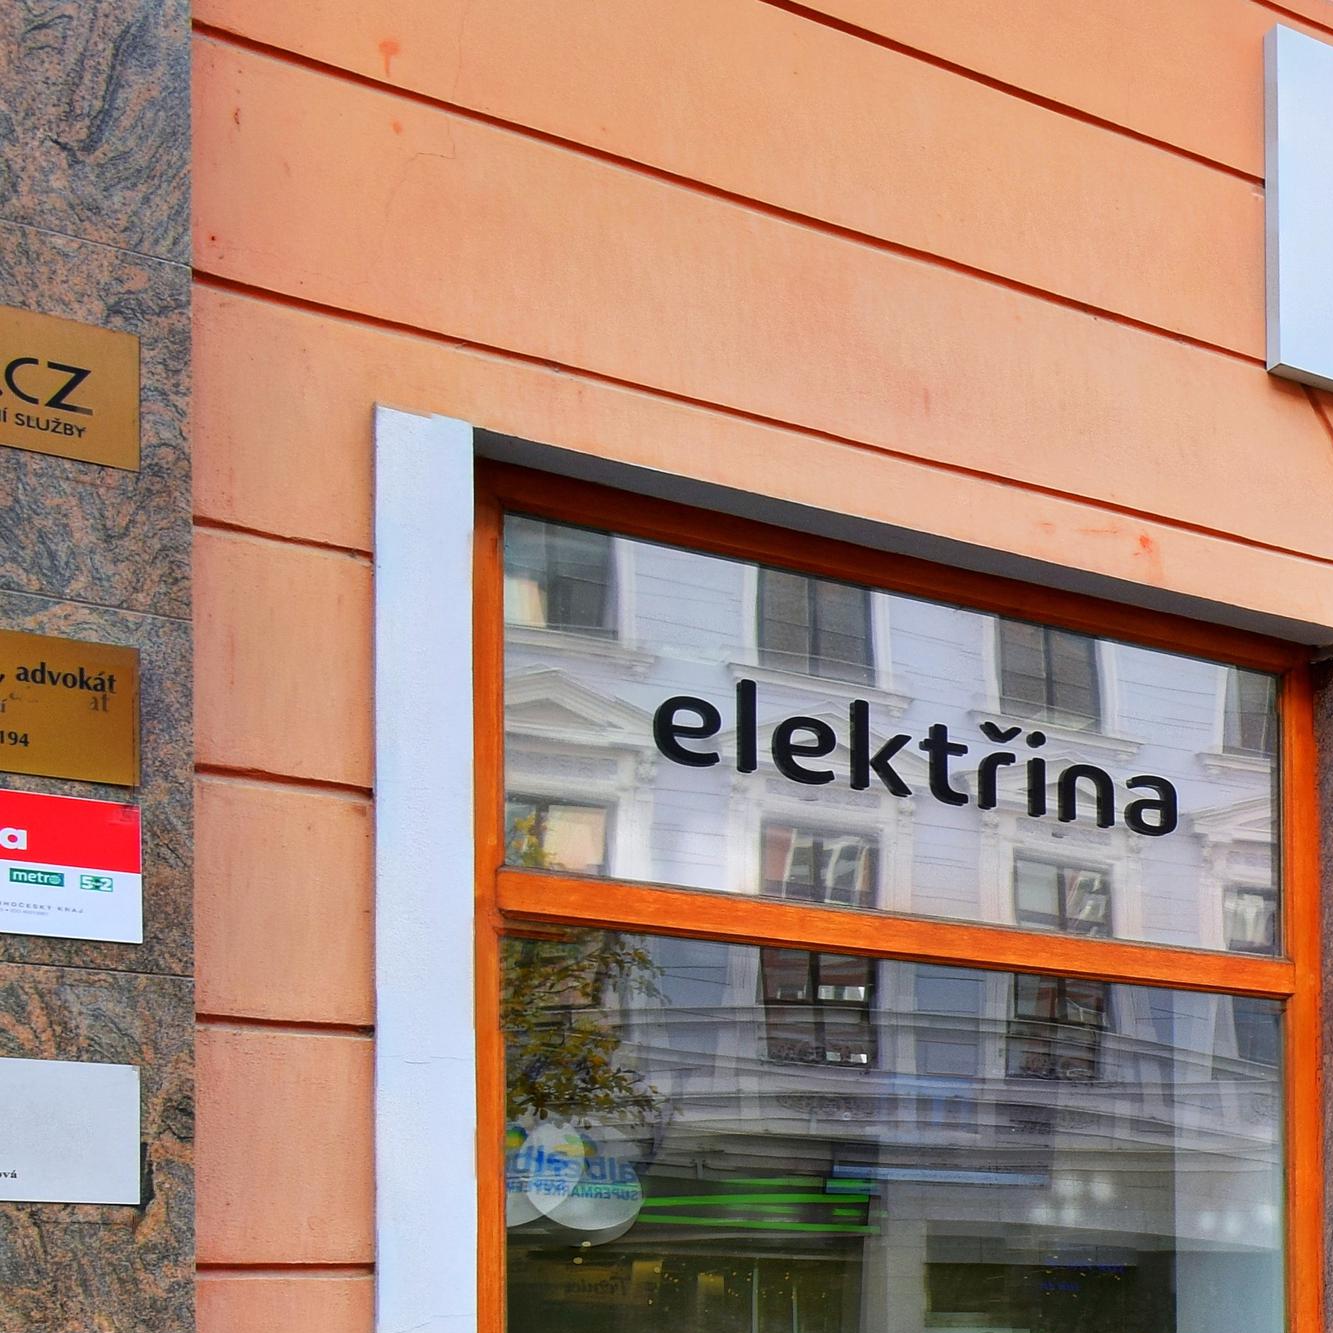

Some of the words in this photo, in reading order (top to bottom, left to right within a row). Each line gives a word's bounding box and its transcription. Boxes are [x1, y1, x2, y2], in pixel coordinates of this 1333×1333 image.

[15, 412, 87, 438] SLUŽBY
[16, 661, 118, 694] advokát
[652, 678, 1179, 838] elektřina
